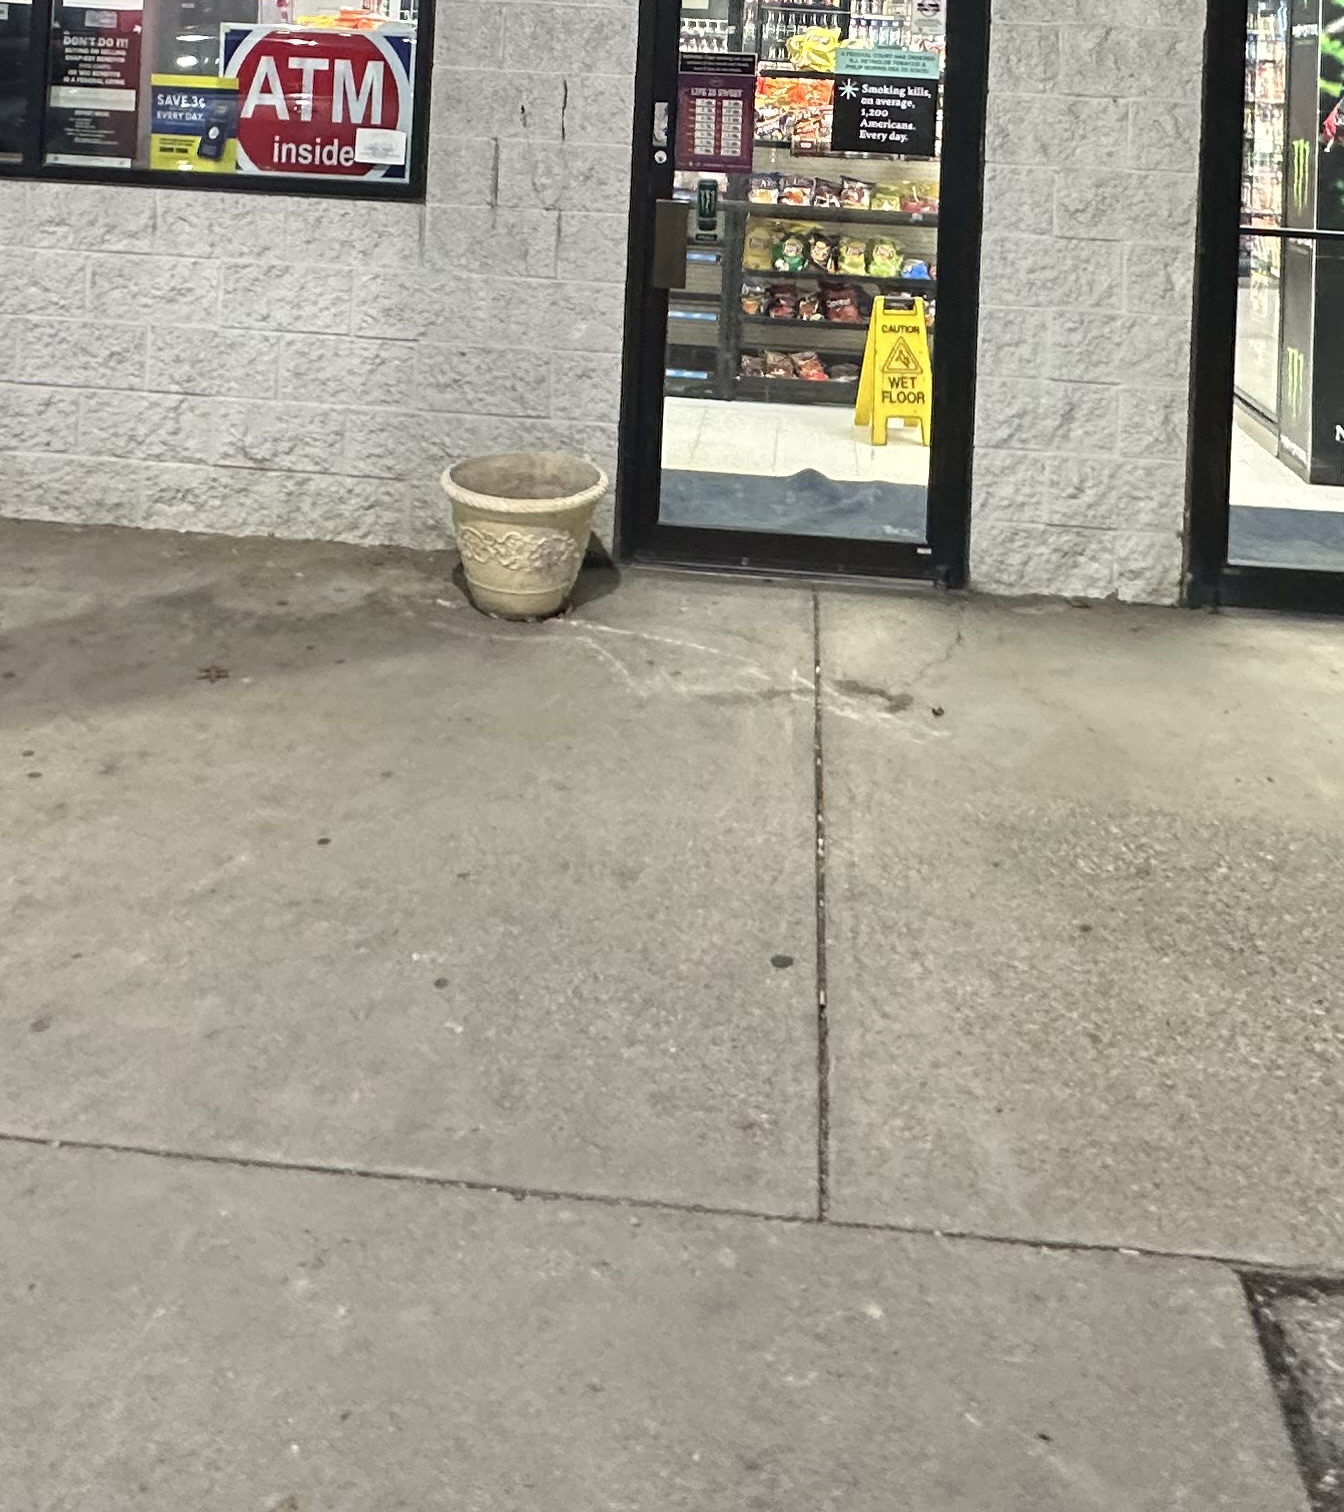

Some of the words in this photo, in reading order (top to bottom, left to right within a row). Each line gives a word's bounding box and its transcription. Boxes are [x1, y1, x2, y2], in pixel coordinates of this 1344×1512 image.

[240, 55, 385, 125] ATM
[861, 83, 906, 98] Smoking
[907, 86, 932, 99] kills,
[157, 93, 191, 108] SAVE
[860, 97, 874, 105] on
[157, 110, 184, 120] EVERY
[860, 108, 889, 119] 1,200
[858, 129, 888, 142] Every
[272, 135, 354, 166] inside
[887, 376, 918, 389] WET
[881, 390, 925, 405] FLOOR
